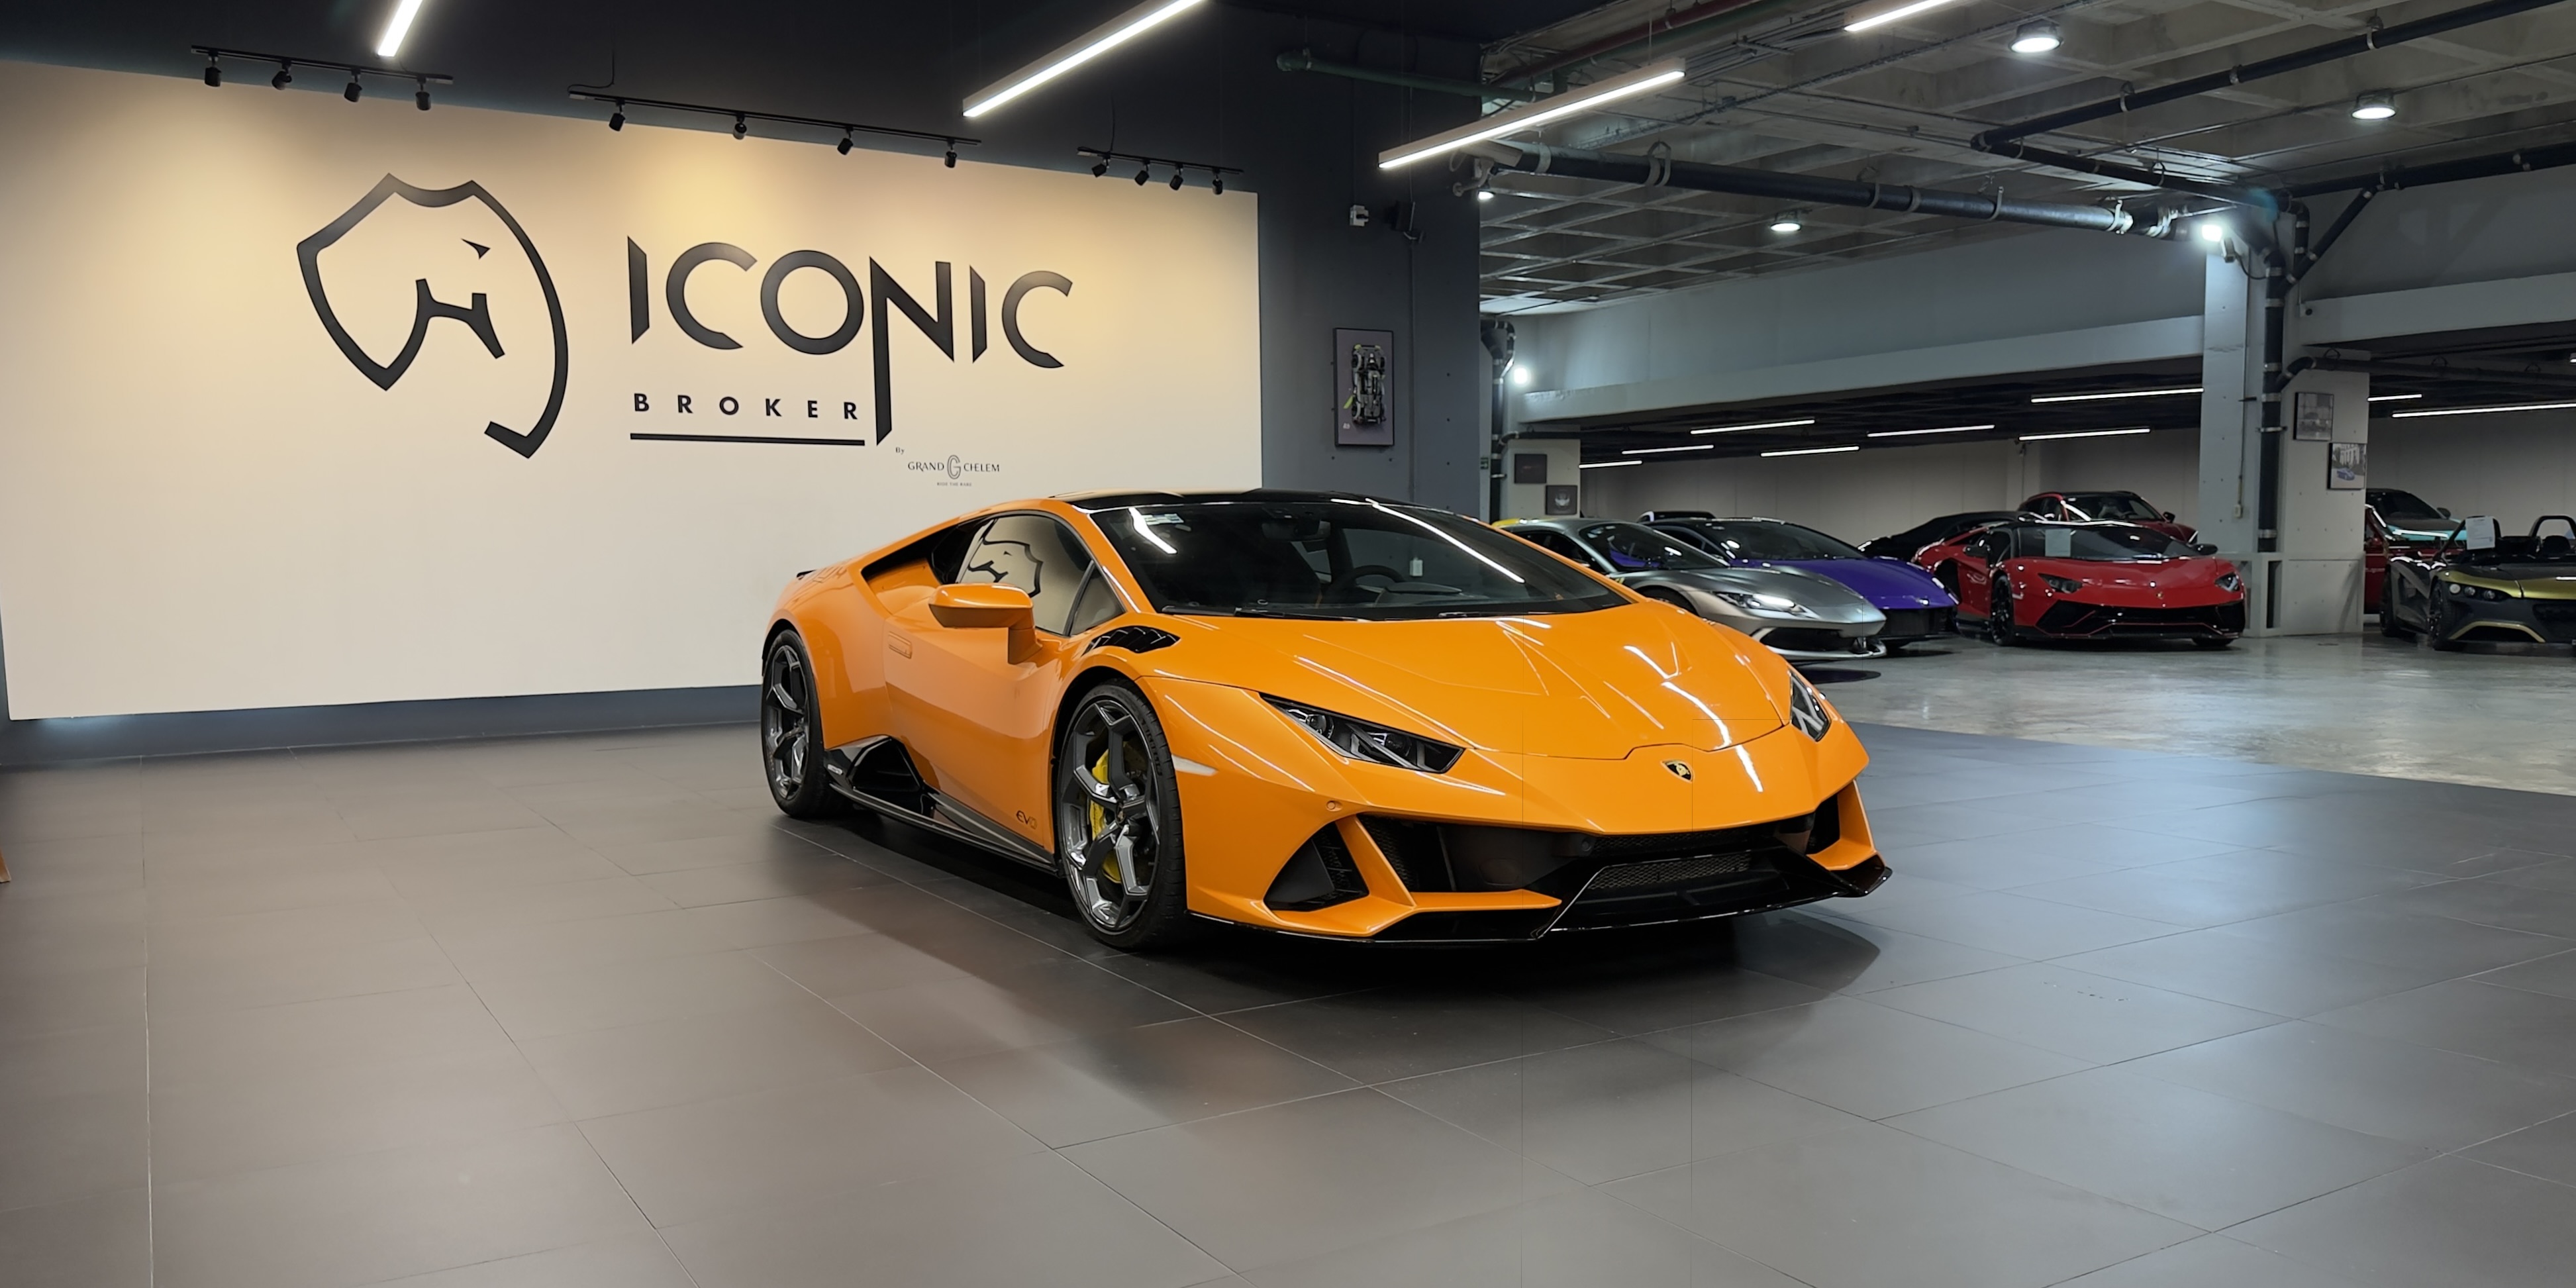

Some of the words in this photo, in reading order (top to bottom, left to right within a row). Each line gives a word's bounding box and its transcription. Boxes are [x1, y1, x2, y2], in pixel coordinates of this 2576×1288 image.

[626, 235, 1073, 446] ICONIC
[634, 393, 858, 420] BROKER
[908, 462, 944, 472] GRAND
[964, 463, 1000, 472] CHELEM
